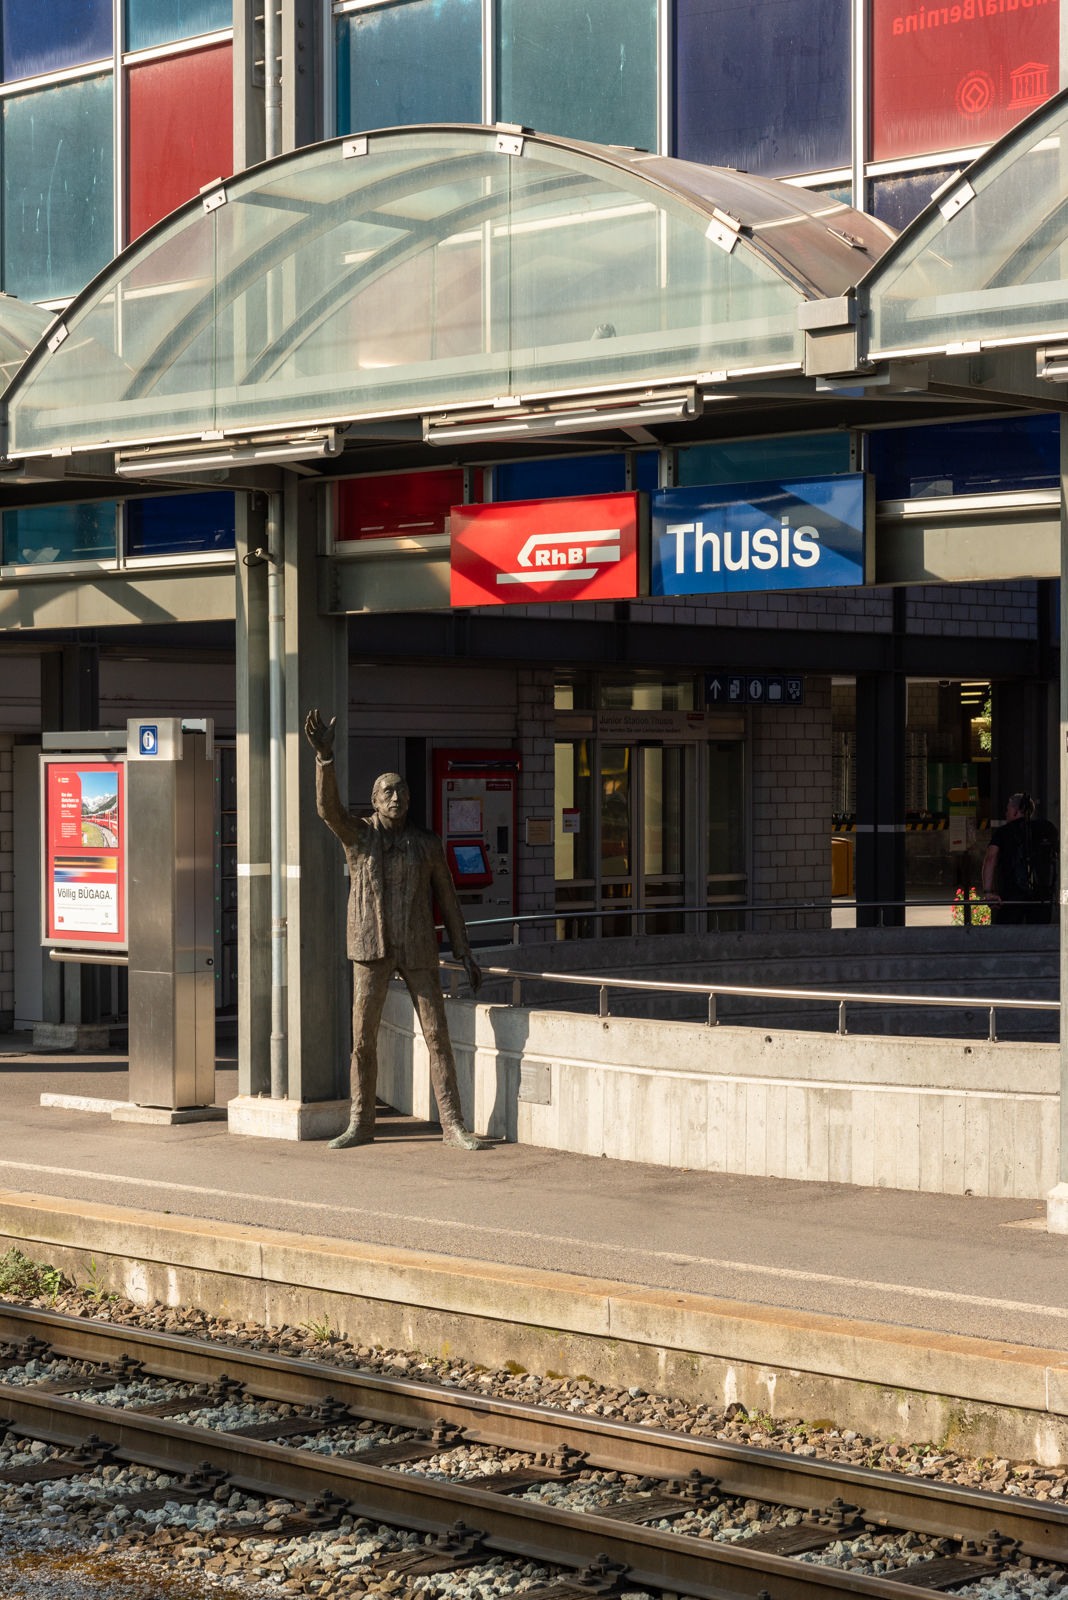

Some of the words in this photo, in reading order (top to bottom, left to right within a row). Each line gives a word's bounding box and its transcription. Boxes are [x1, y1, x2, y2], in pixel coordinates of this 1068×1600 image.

[666, 516, 820, 574] Thusis
[535, 548, 583, 567] RhB
[599, 716, 622, 725] Junior
[623, 716, 649, 725] Station
[651, 716, 674, 725] Thusis
[57, 887, 77, 901] Völlig
